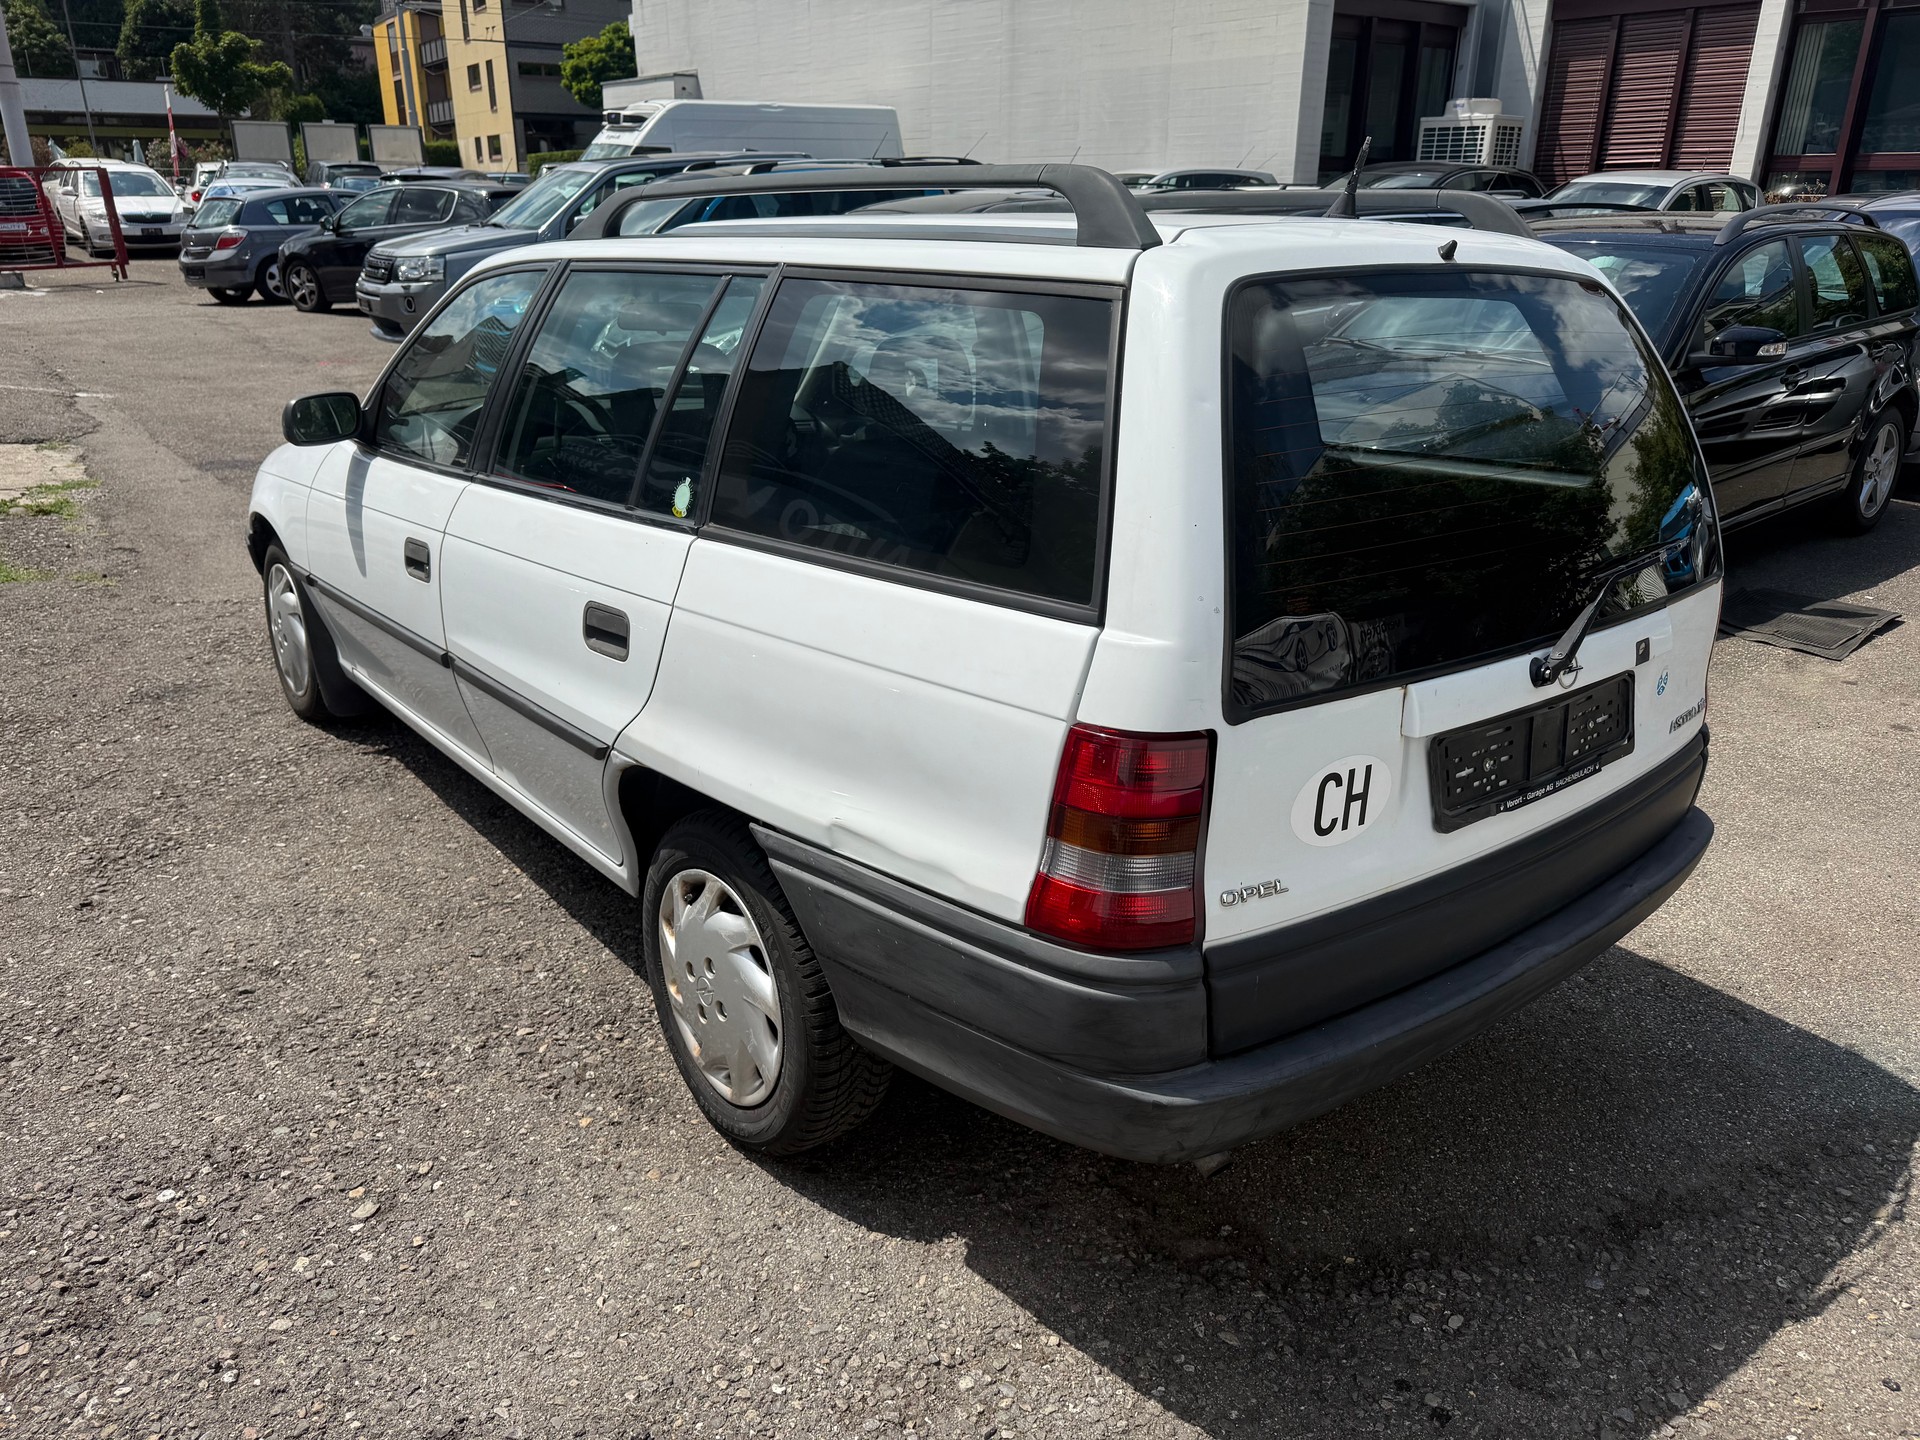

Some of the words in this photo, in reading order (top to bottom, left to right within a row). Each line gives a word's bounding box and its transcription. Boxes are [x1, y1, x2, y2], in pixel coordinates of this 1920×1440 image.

[1313, 764, 1373, 837] CH
[1506, 796, 1522, 808] Vorort
[1527, 788, 1545, 799] Garage
[1546, 783, 1554, 792] AG
[1220, 878, 1290, 907] OPEL
